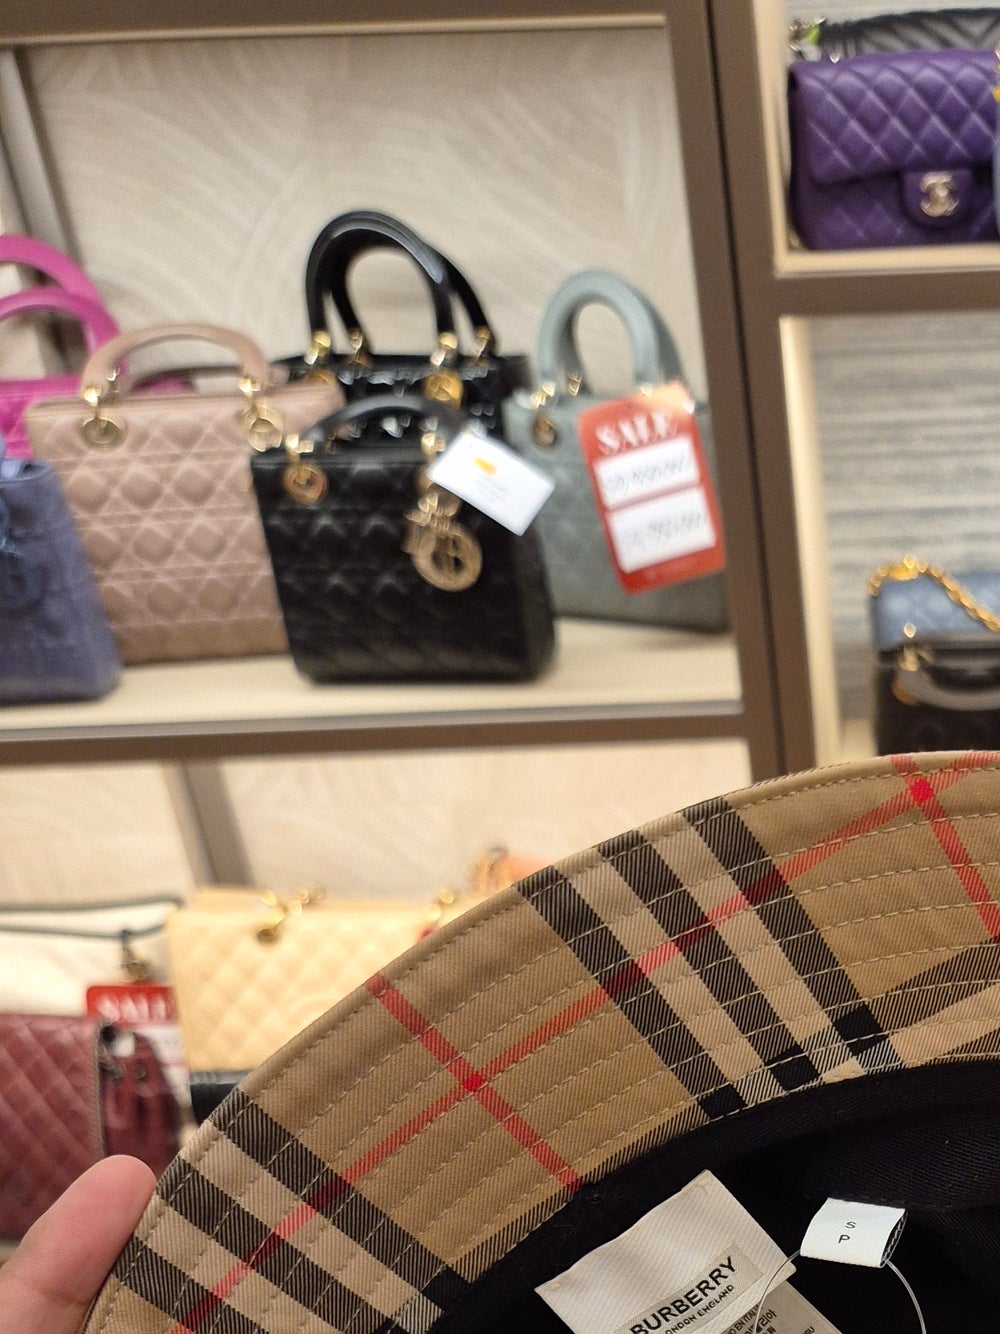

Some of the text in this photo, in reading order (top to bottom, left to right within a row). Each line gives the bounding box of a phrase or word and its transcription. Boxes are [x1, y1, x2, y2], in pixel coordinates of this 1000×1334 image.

[845, 1221, 857, 1229] S
[838, 1234, 851, 1244] P
[697, 1284, 735, 1317] ENGLAND
